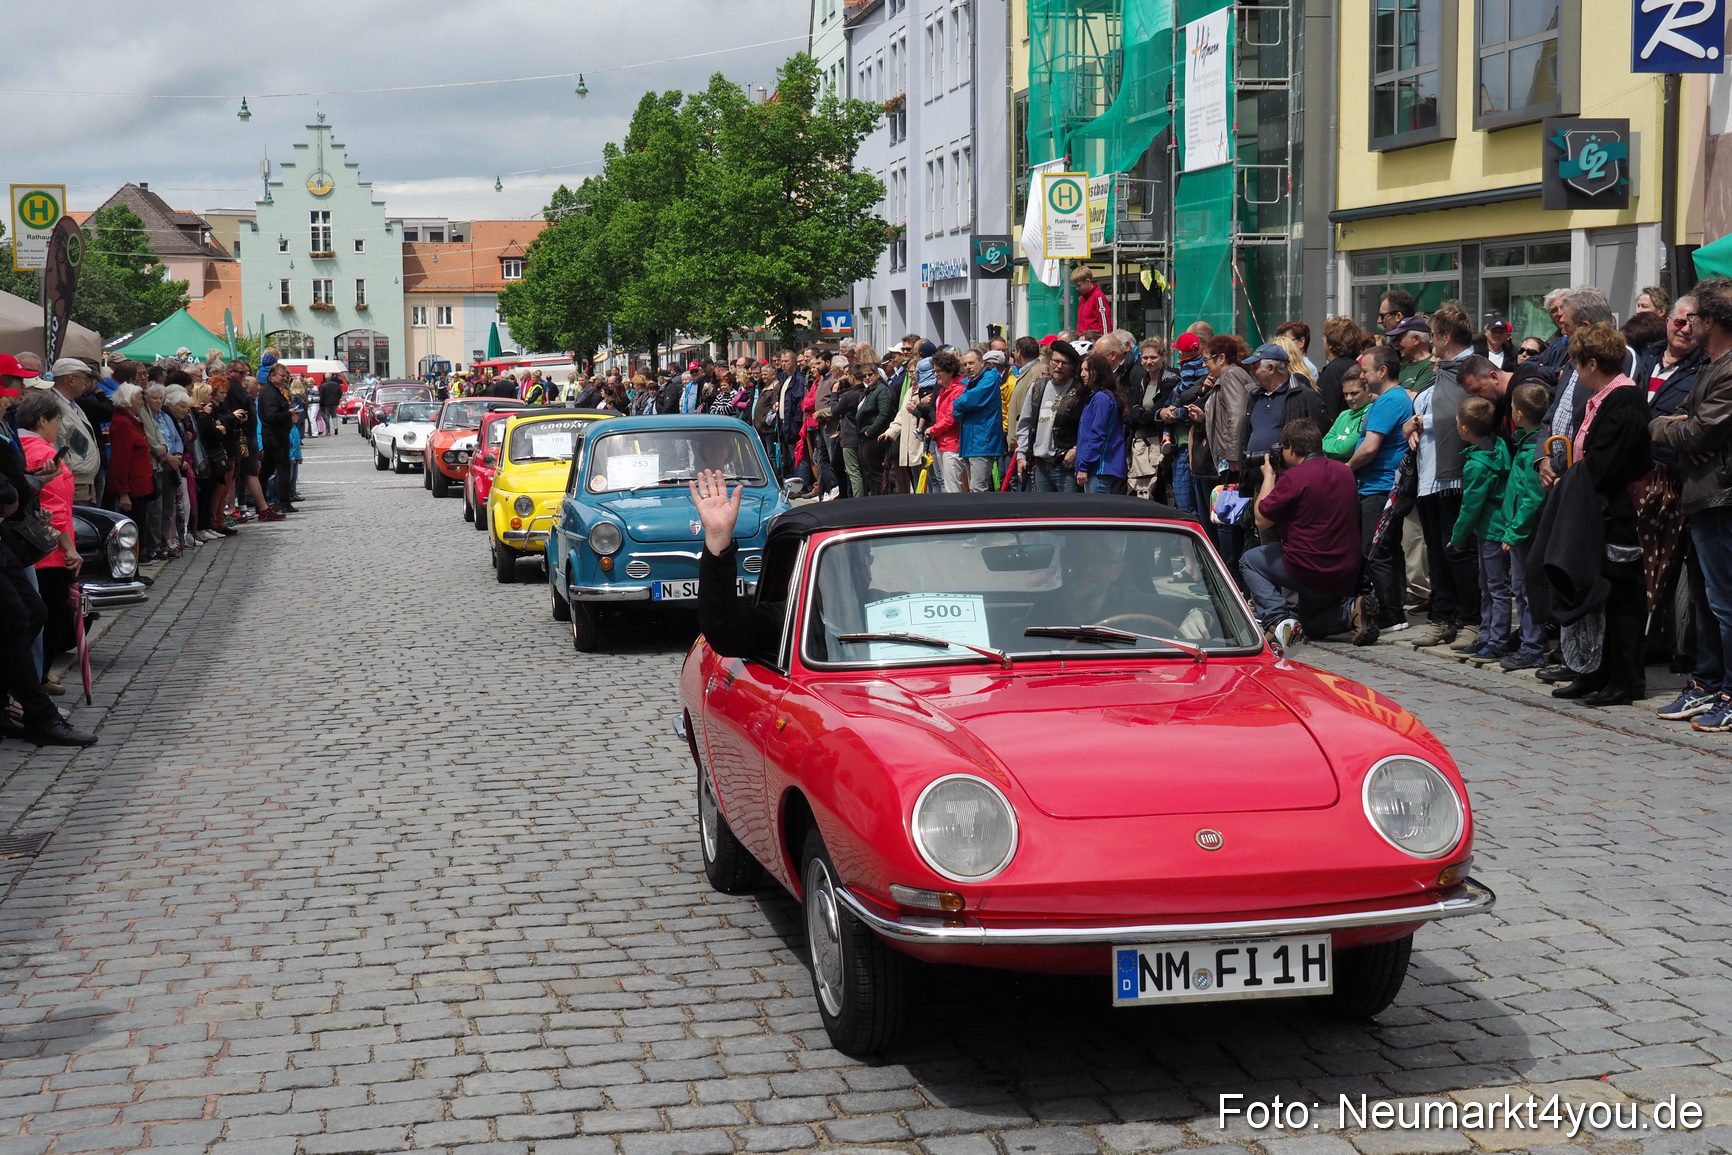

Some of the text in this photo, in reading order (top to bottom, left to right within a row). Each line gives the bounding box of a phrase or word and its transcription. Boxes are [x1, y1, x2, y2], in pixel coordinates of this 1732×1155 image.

[1579, 143, 1608, 180] G2
[985, 246, 1001, 265] G2
[632, 460, 649, 468] 253
[662, 583, 672, 598] N
[924, 604, 962, 619] 500
[1201, 833, 1218, 844] FIAT
[1138, 951, 1190, 992] NM
